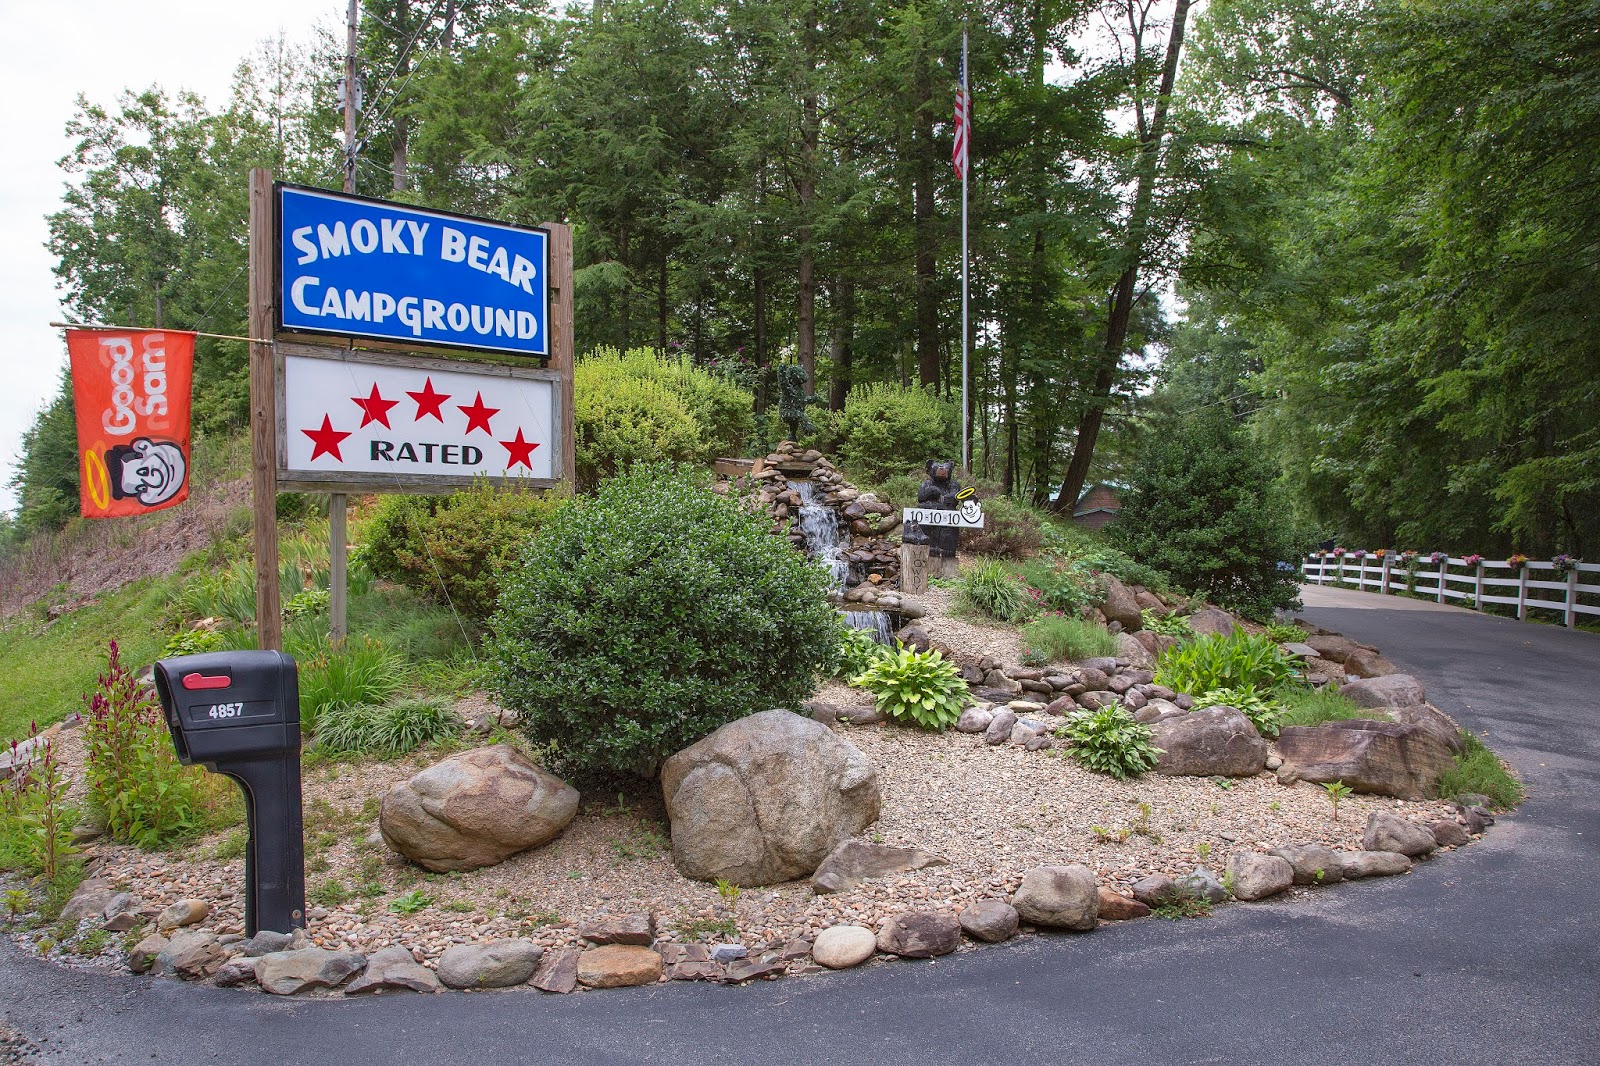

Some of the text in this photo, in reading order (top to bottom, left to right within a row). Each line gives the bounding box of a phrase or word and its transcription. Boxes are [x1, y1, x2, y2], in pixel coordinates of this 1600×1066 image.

[291, 218, 536, 295] SMOKY BEAR
[290, 275, 538, 340] CAMPGROUND
[98, 336, 137, 436] Good
[134, 333, 169, 416] Sam
[370, 440, 483, 465] RATED
[911, 549, 923, 595] HOWDY
[208, 702, 244, 719] 4857
